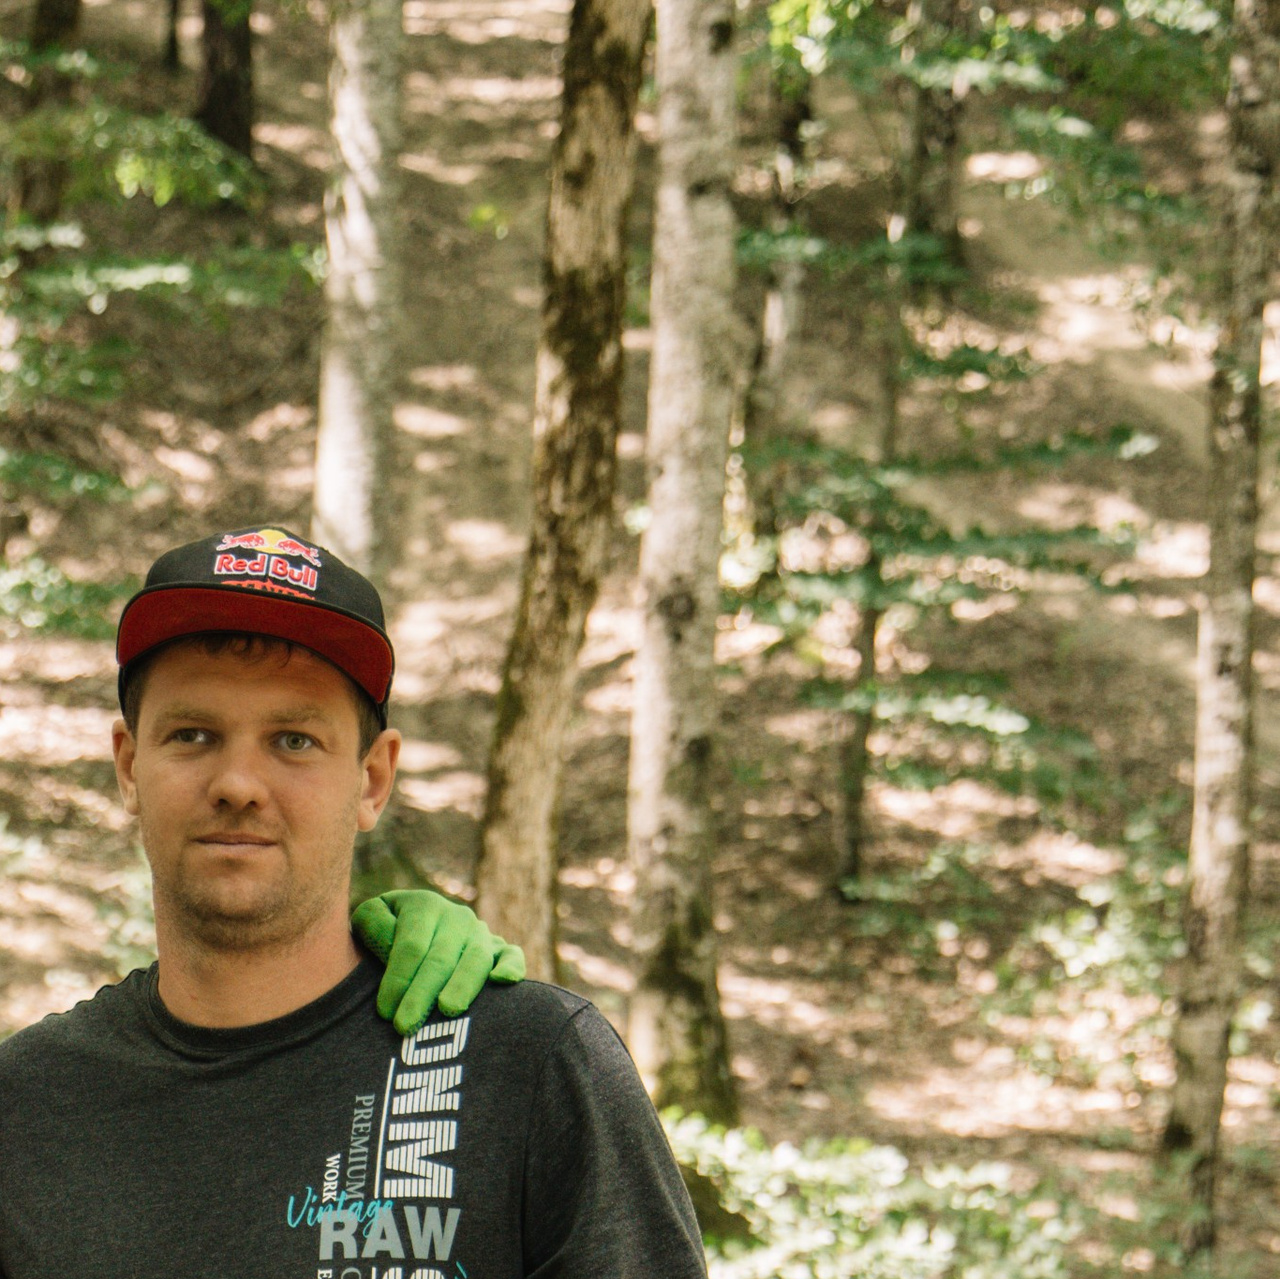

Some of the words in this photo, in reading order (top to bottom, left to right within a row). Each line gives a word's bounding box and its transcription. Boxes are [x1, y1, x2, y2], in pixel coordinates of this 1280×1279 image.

[215, 553, 267, 575] Red
[269, 556, 317, 591] Bull
[347, 1093, 375, 1200] PREMIUM
[322, 1153, 341, 1203] WORK
[287, 1186, 394, 1238] Vintage
[319, 1205, 461, 1262] RAW
